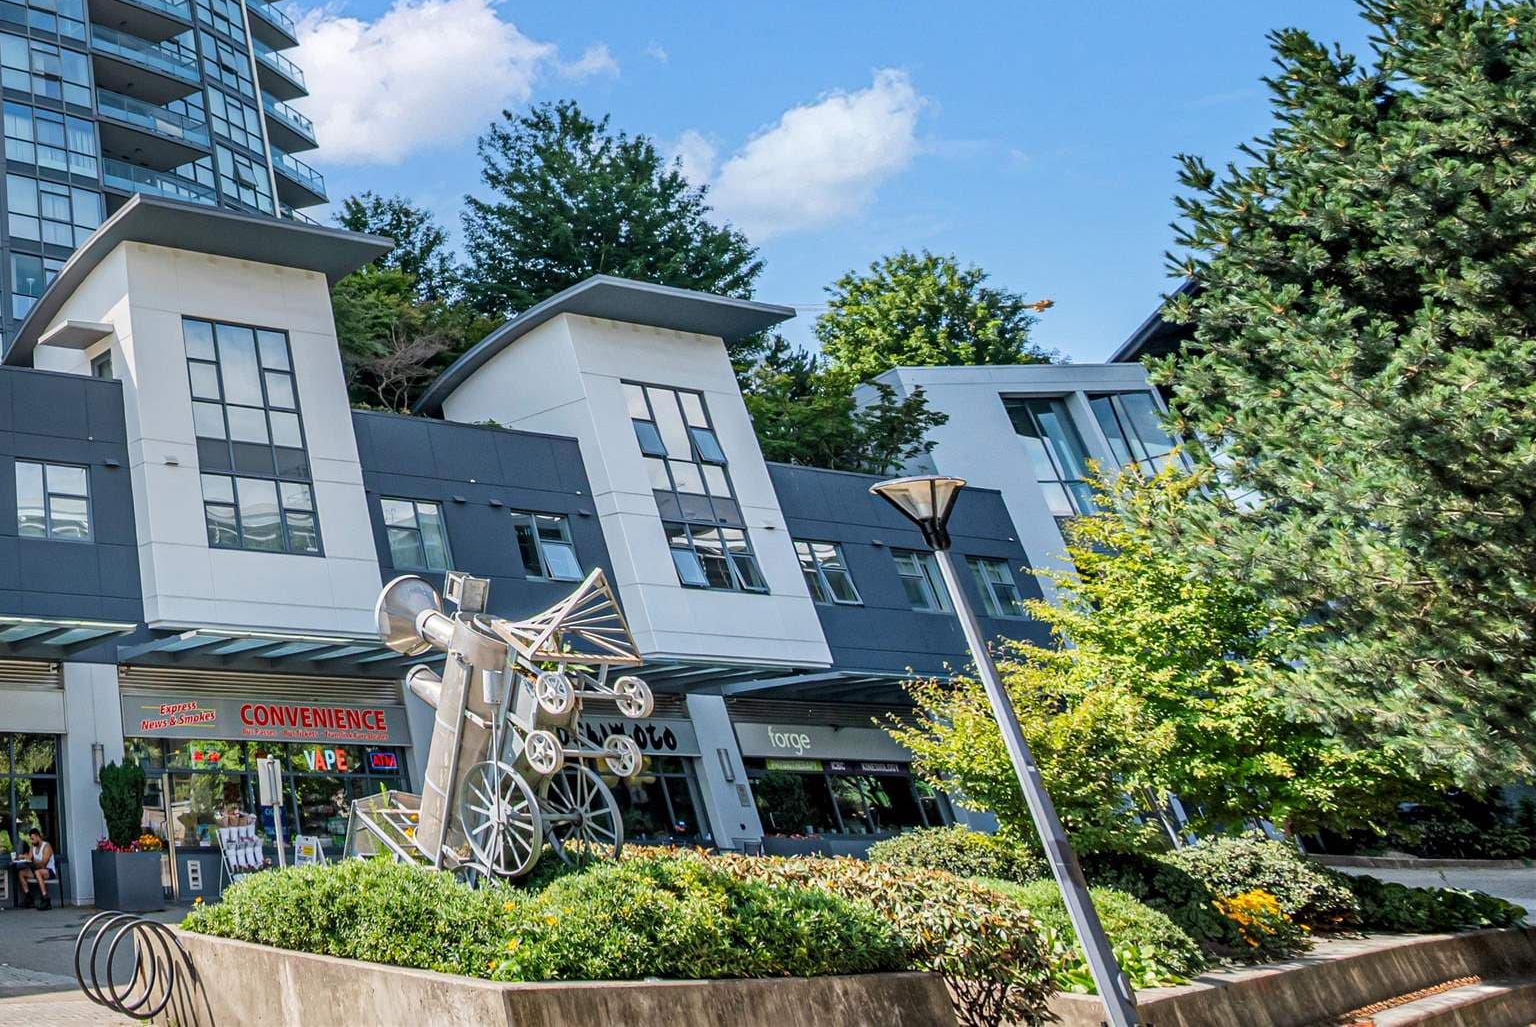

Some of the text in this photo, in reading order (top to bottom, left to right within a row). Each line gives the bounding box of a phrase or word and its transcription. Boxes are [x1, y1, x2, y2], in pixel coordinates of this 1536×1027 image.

[159, 701, 197, 715] Express
[239, 703, 388, 732] CONVENIENCE
[141, 711, 216, 731] News & Smokes
[767, 726, 811, 756] forge
[303, 748, 348, 771] VAPE
[372, 753, 396, 766] ATM
